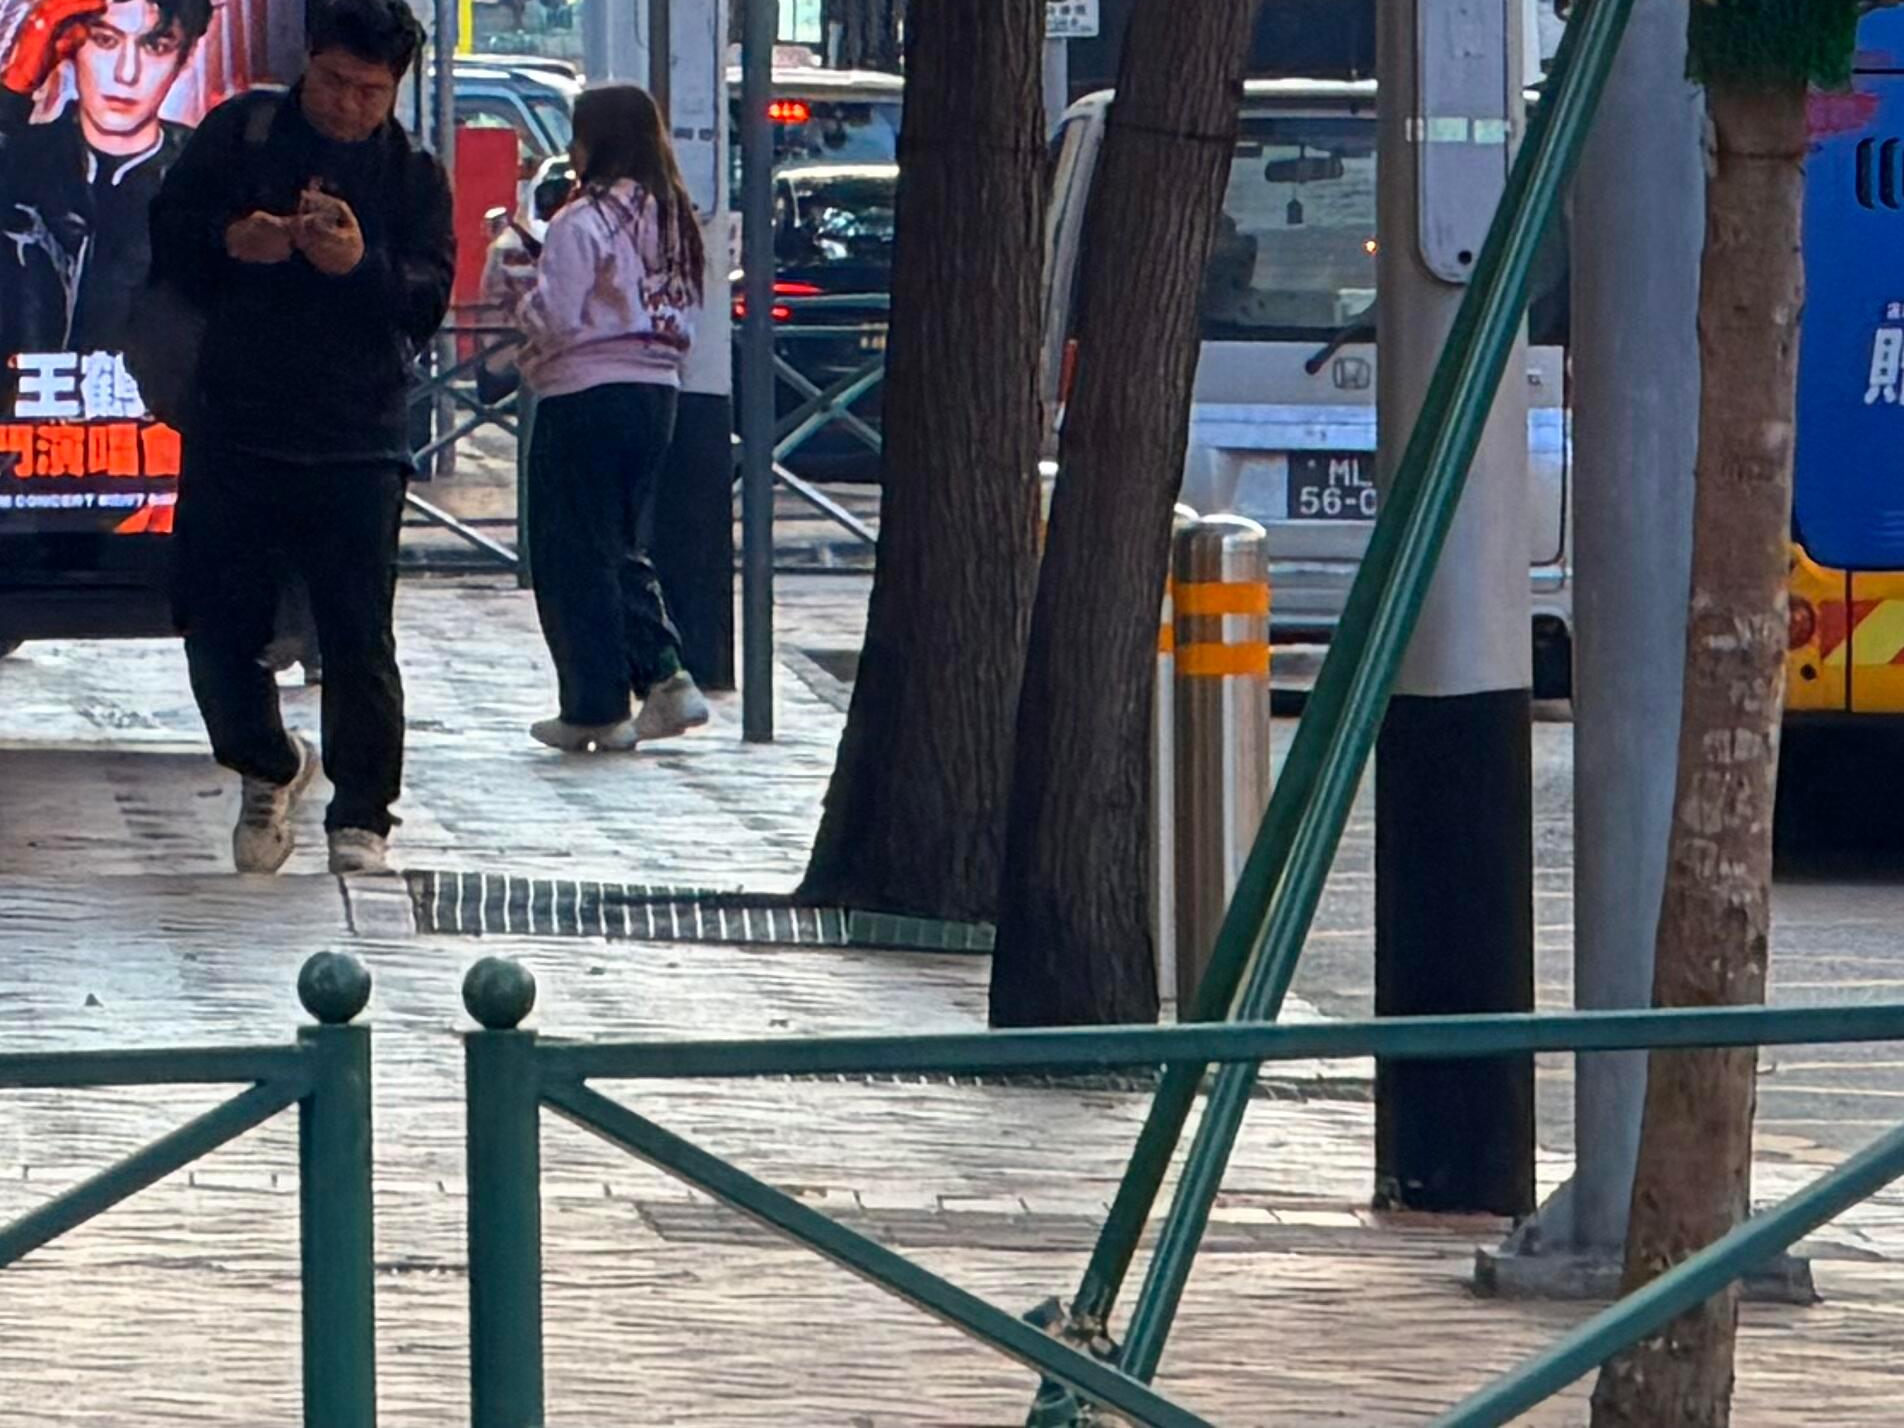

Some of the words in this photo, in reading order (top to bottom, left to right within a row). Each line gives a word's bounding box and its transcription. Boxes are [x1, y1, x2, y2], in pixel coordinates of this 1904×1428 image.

[15, 350, 145, 419] 王鶴
[1328, 459, 1373, 486] ML
[1299, 486, 1377, 516] 56-0
